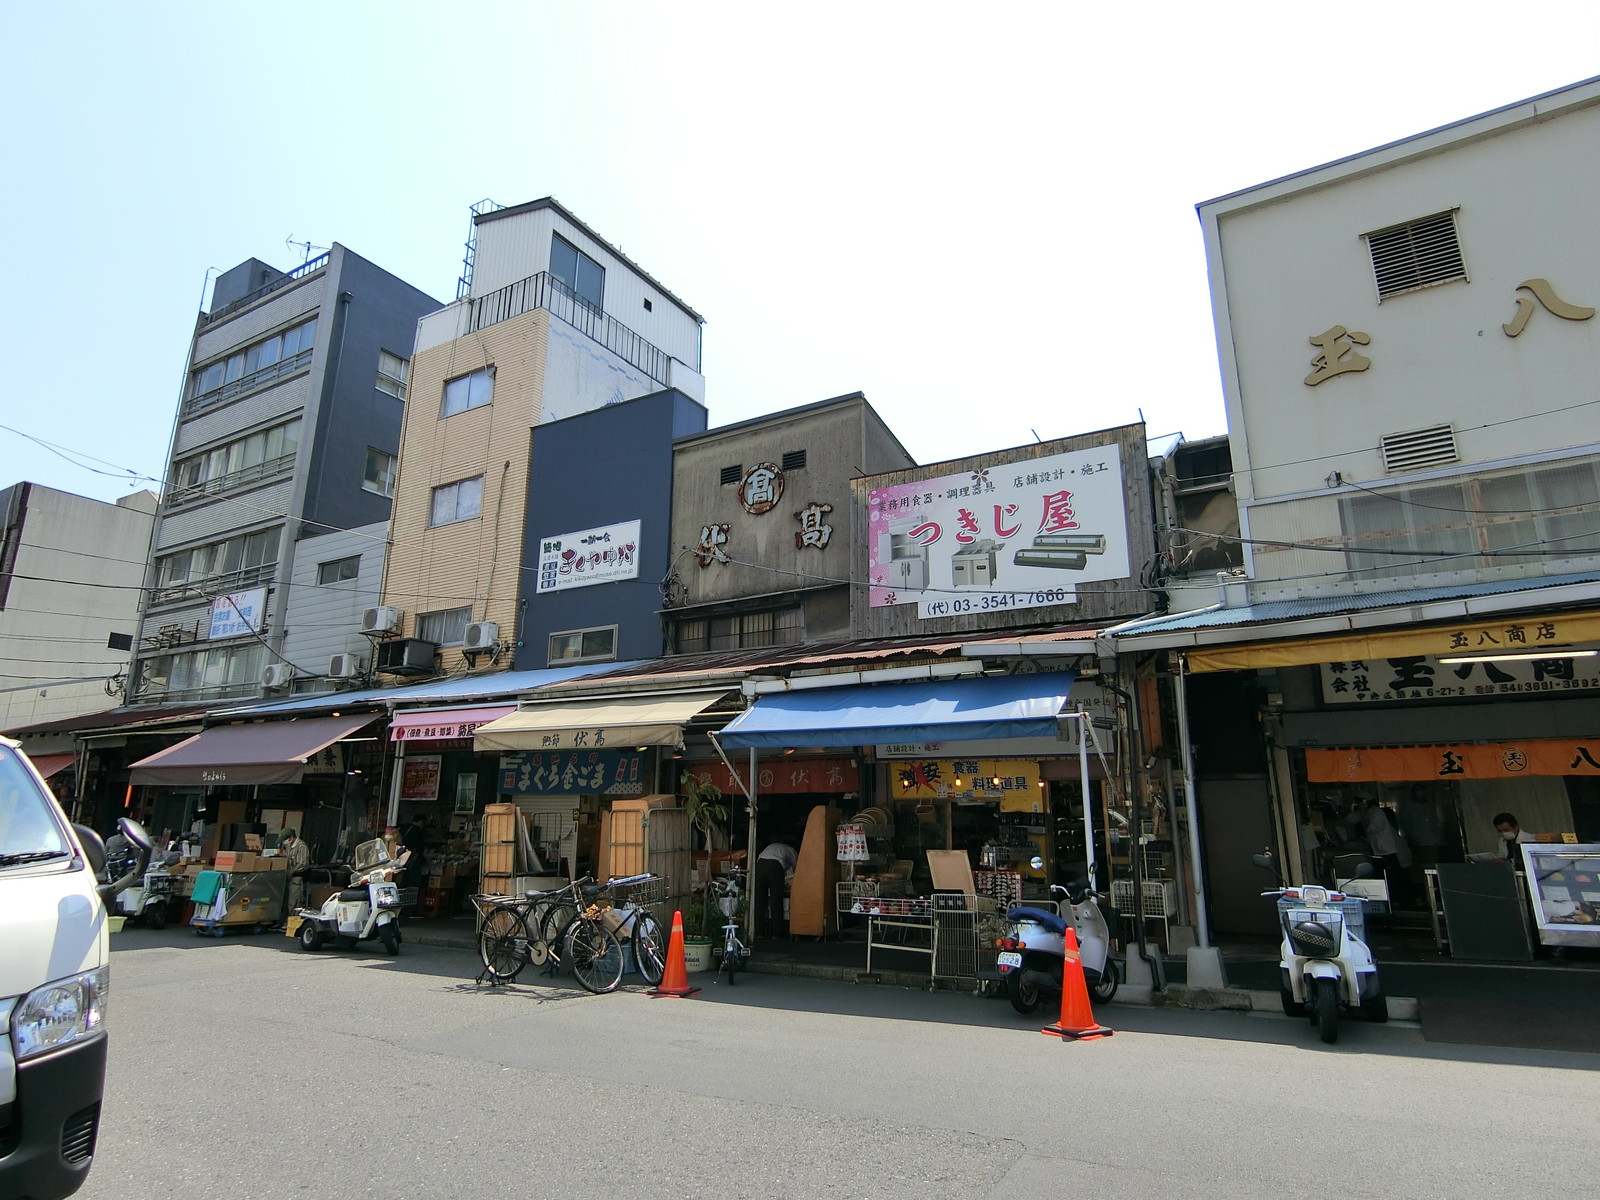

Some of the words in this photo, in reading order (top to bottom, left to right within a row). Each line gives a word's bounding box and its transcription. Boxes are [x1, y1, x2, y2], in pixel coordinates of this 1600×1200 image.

[877, 481, 997, 512] 業務用食器・調理器具
[1013, 462, 1109, 489] 店舗設計・施工
[907, 490, 1081, 547] つきじ屋
[1449, 622, 1556, 650] 玉八商店
[1330, 675, 1371, 693] 会社
[457, 722, 484, 738] 菊屋
[952, 760, 980, 775] 食器
[1438, 750, 1466, 776] 玉
[517, 761, 606, 792] まぐろ金ごま
[971, 775, 1029, 791] 料理道具
